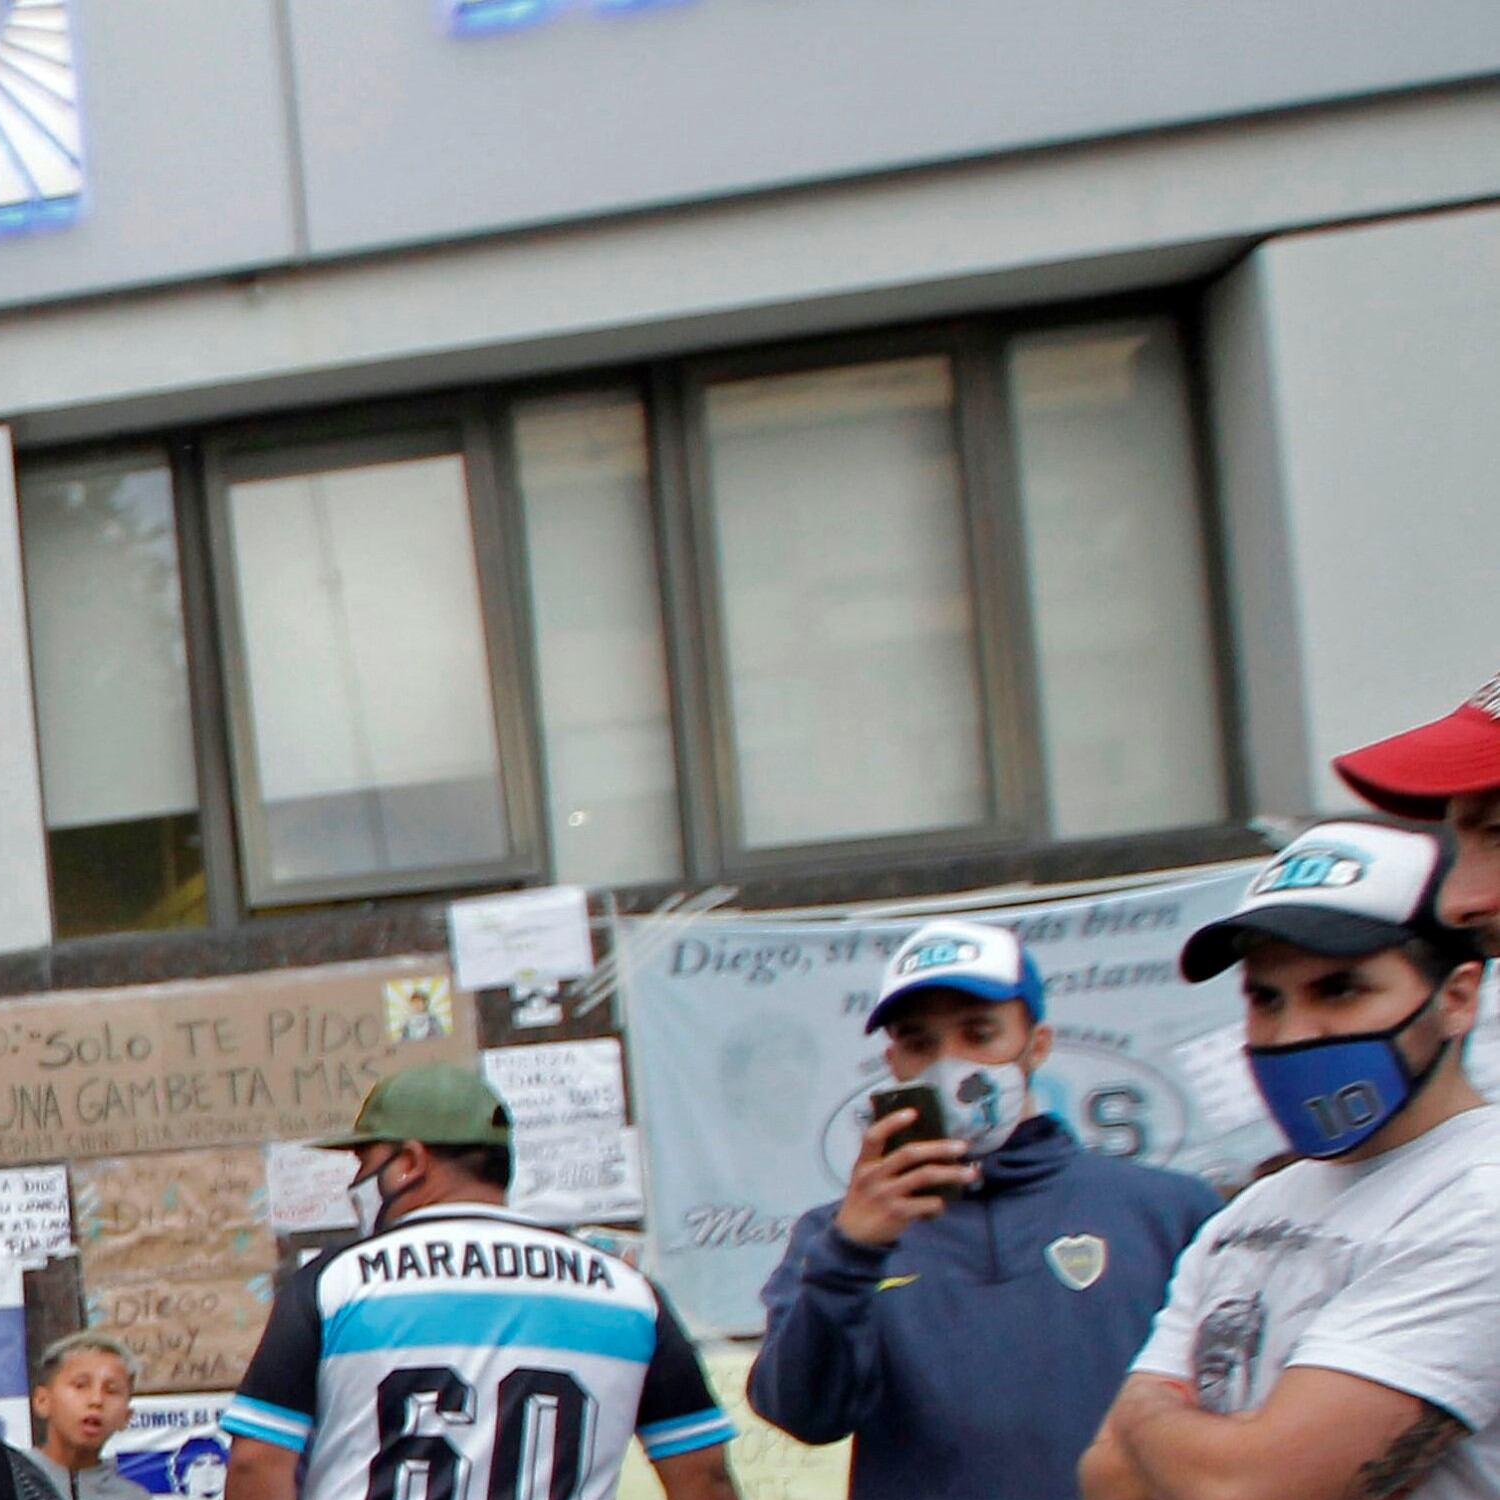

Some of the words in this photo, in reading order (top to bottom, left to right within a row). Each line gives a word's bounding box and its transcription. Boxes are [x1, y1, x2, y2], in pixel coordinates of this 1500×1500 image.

[668, 935, 813, 984] Diego,
[174, 1015, 240, 1057] TE
[76, 1066, 275, 1126] GAMBETA
[1303, 1080, 1384, 1140] 10
[357, 1240, 615, 1290] MARADONA
